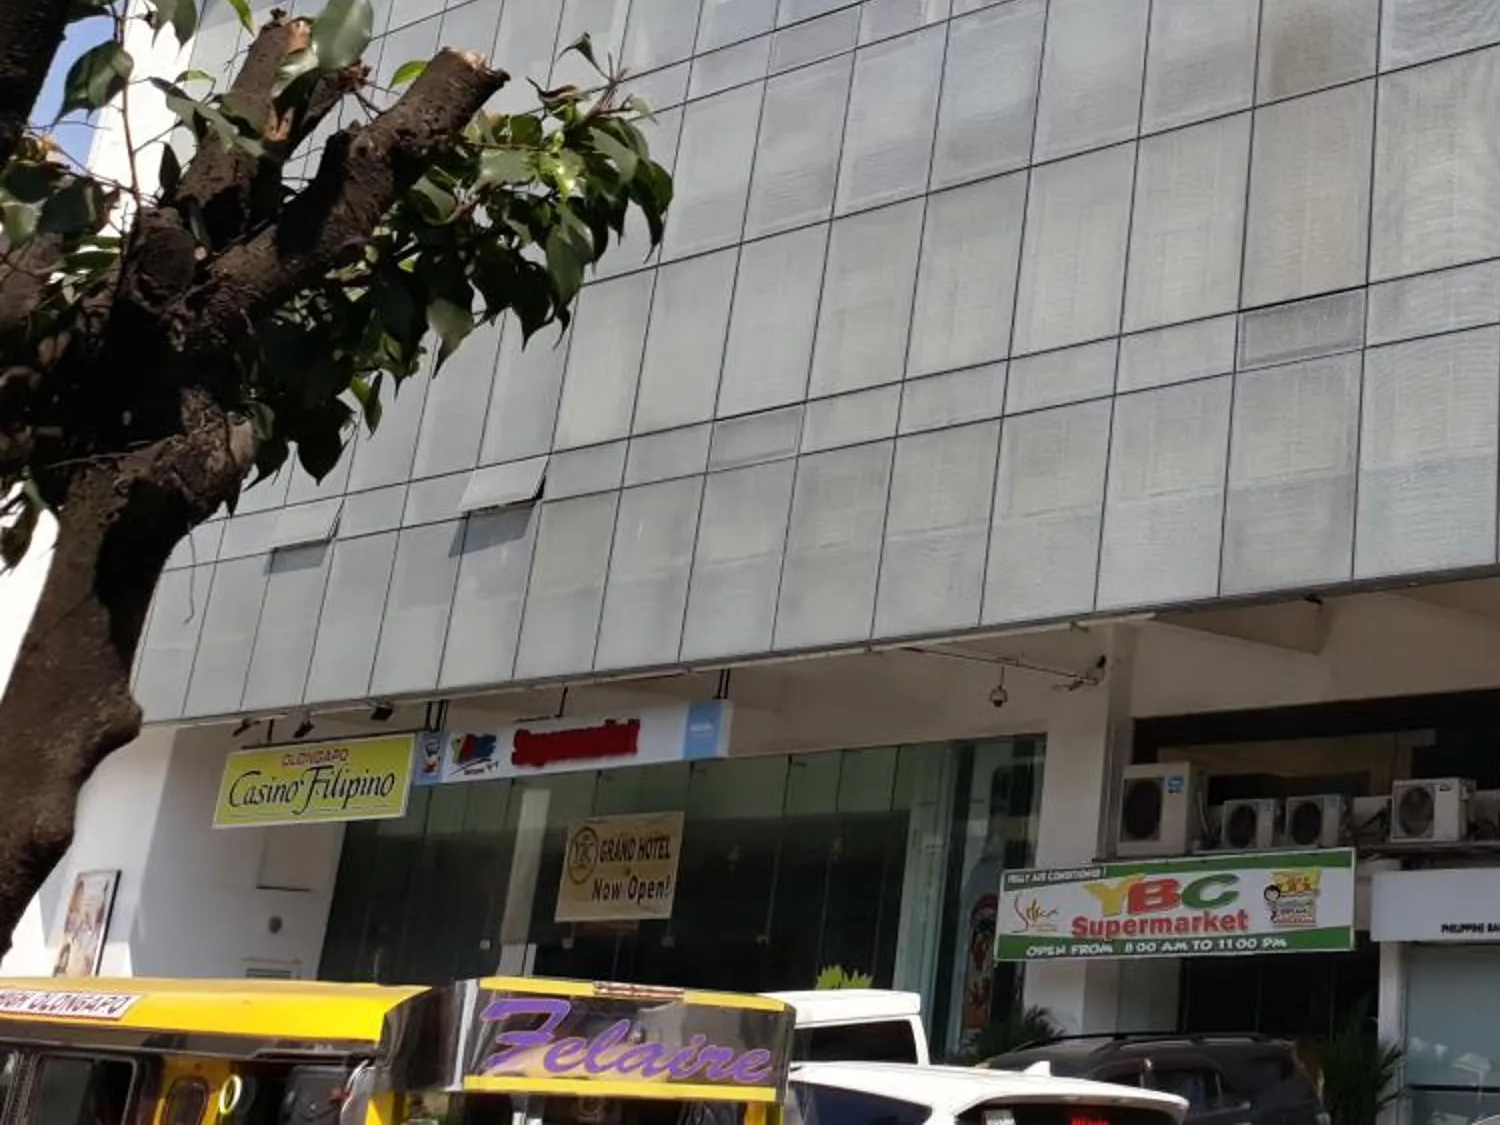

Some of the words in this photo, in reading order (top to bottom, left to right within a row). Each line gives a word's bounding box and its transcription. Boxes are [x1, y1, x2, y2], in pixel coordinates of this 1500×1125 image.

[228, 770, 304, 808] Casino
[291, 764, 396, 816] Filipino
[599, 835, 637, 864] GRAND
[639, 835, 671, 860] HOTEL
[591, 877, 622, 902] Now
[627, 874, 671, 907] Open!
[1084, 872, 1239, 917] YBC
[1071, 908, 1248, 938] Supermarket
[1441, 922, 1484, 934] PHILIPPINE
[1025, 945, 1067, 957] OPEN
[1071, 942, 1113, 956] FROM
[1161, 940, 1188, 952] AM
[1192, 939, 1213, 951] TO
[1261, 937, 1287, 949] PM
[480, 998, 772, 1083] Felaire
